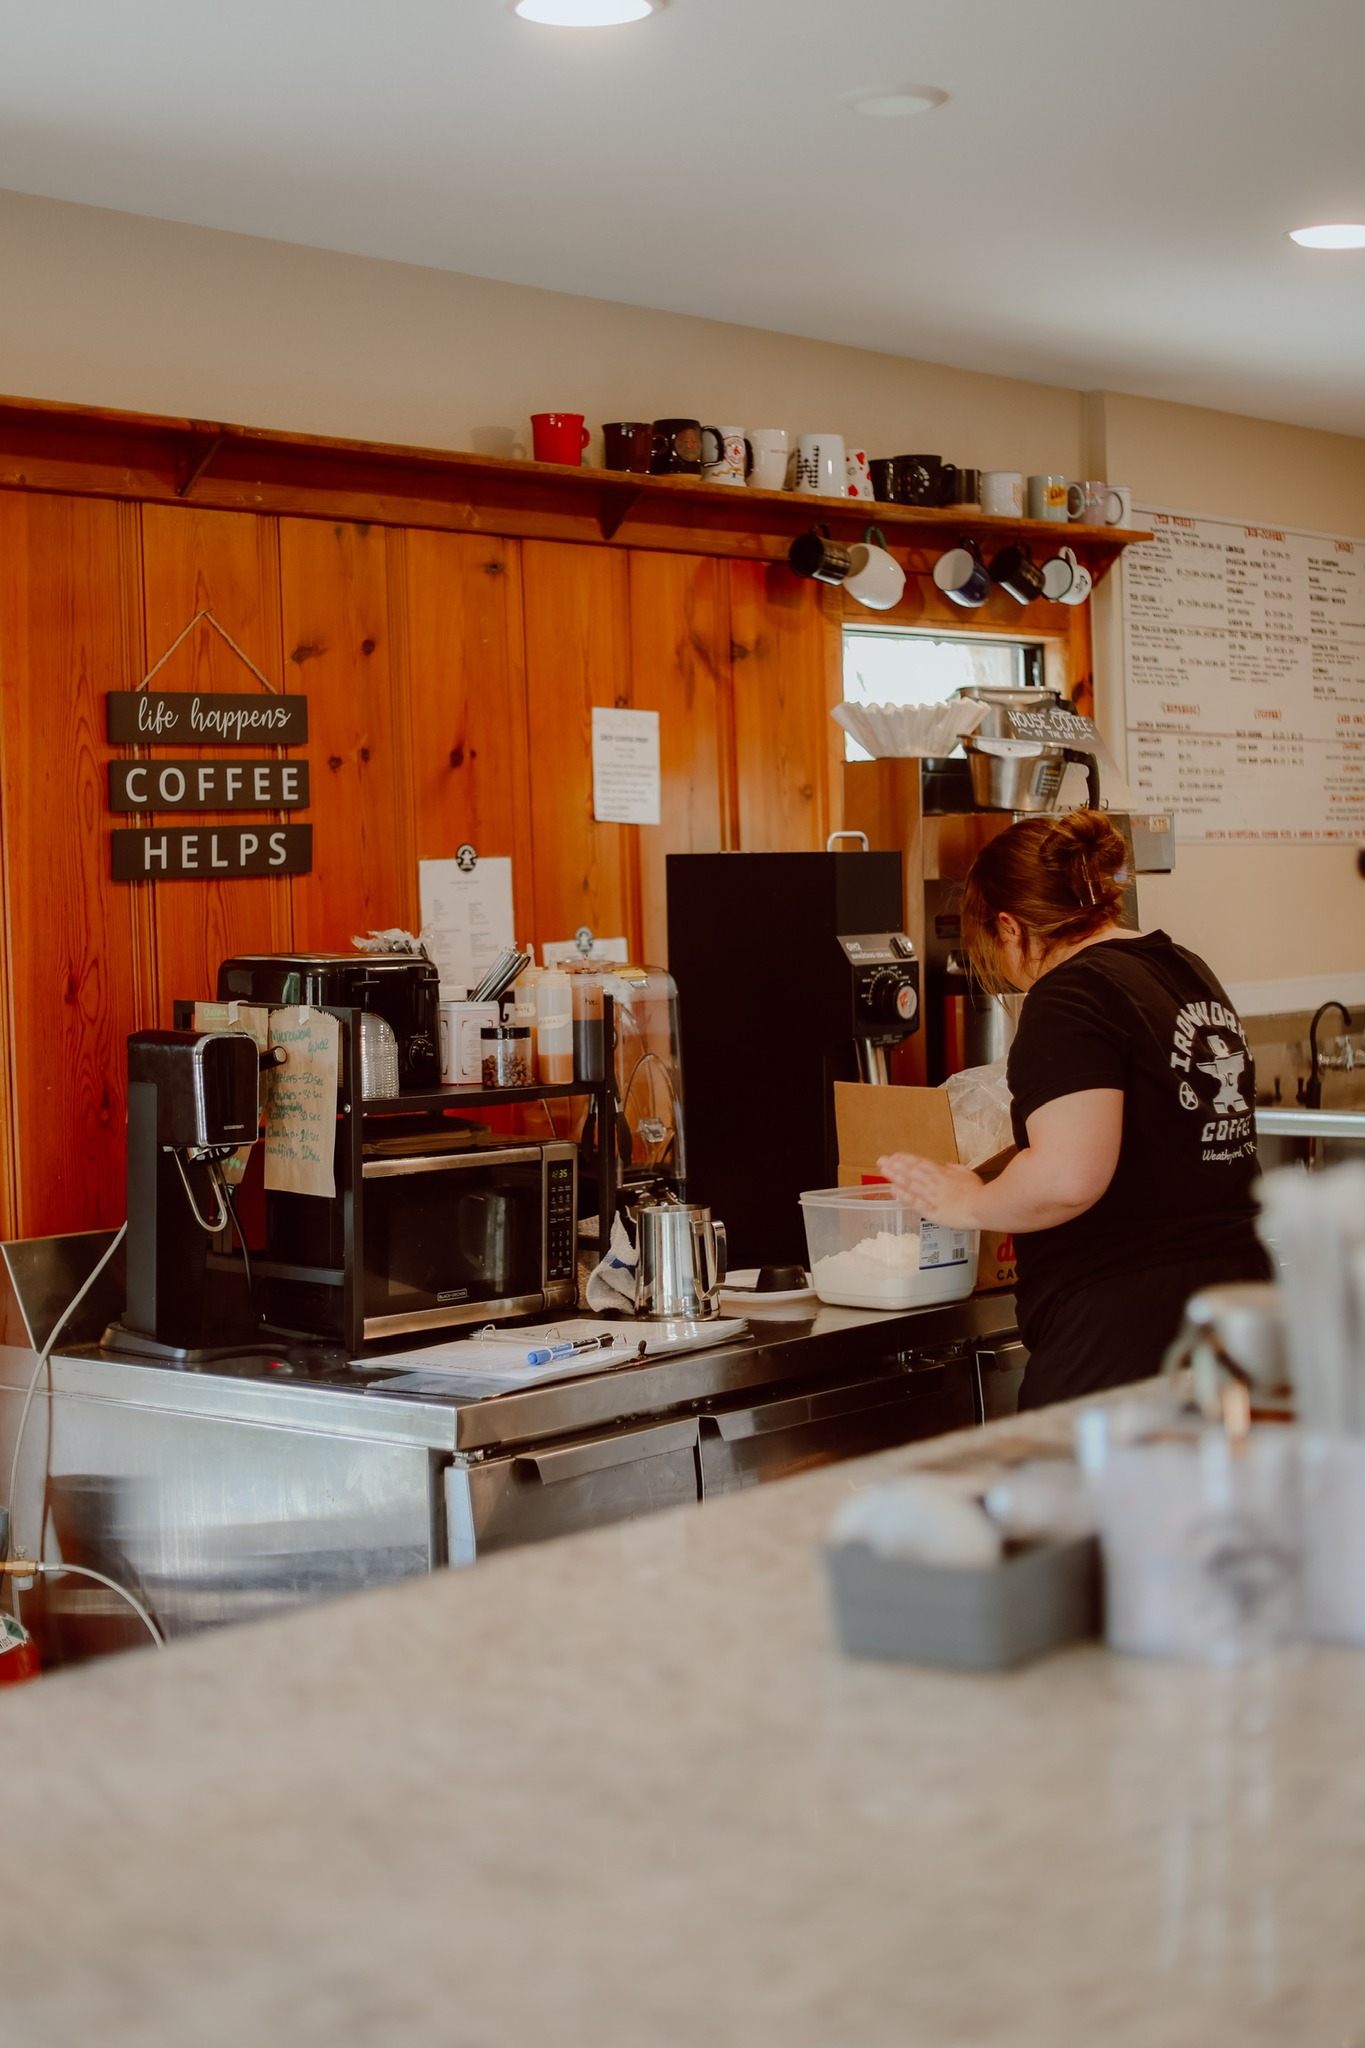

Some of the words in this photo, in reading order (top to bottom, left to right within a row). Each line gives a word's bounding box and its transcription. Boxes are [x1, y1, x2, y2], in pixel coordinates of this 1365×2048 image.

[138, 697, 179, 734] life
[190, 698, 291, 741] happens
[1007, 711, 1051, 730] HOUSE
[1050, 714, 1092, 733] COFFEE
[1047, 730, 1061, 739] THE
[125, 767, 299, 803] COFFEE
[144, 831, 287, 870] HELPS
[1170, 1001, 1253, 1073] IRONWORK
[1201, 1114, 1252, 1142] COFFE
[1243, 1141, 1257, 1155] TX
[996, 1268, 1015, 1280] CA
